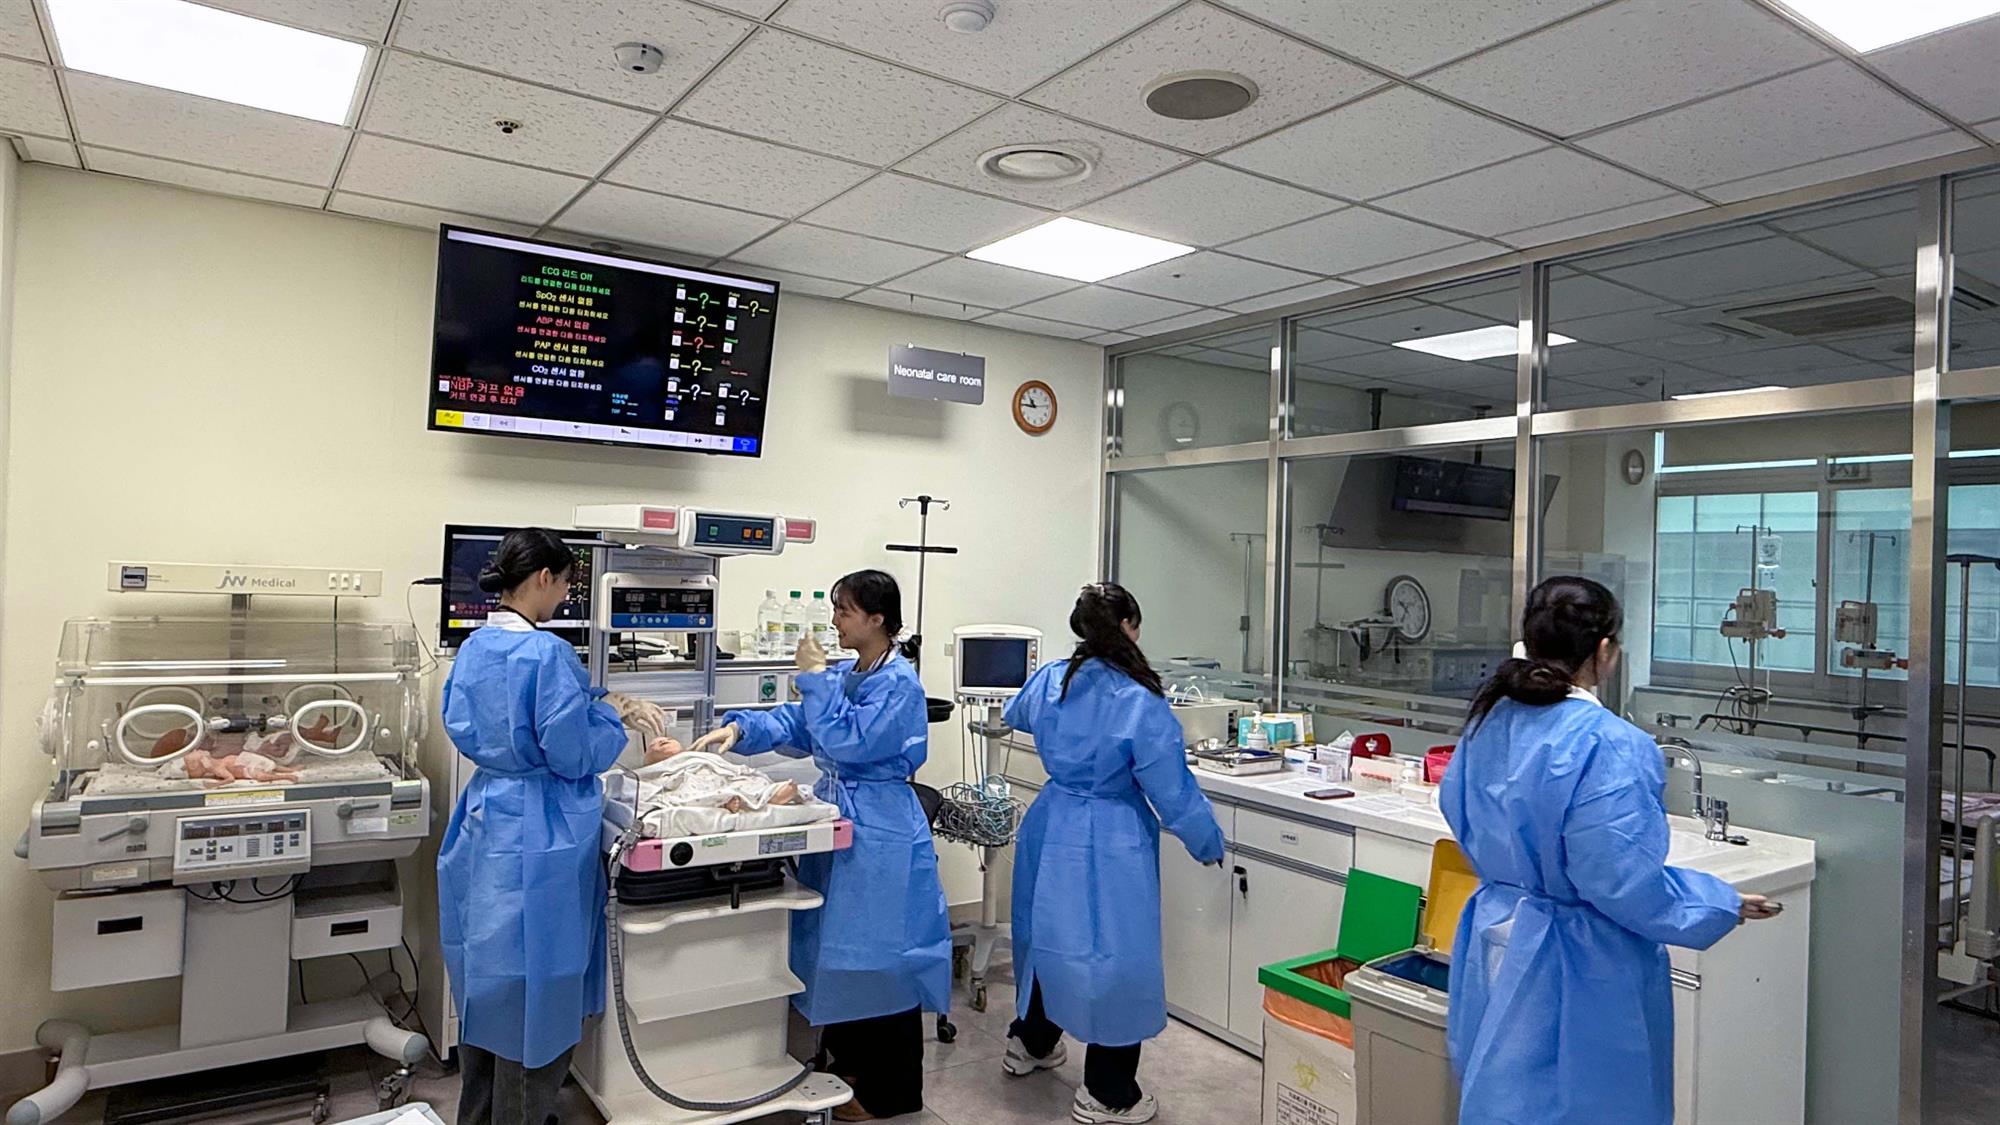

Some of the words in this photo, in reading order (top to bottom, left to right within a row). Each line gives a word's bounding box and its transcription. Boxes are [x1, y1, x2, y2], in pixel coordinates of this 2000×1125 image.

[542, 266, 560, 276] ECG
[562, 269, 578, 279] 리드
[580, 273, 593, 281] Off
[559, 294, 575, 304] 센서
[555, 319, 571, 328] 센서
[534, 340, 551, 349] PAP
[553, 342, 569, 352] 센서
[551, 366, 567, 376] 센서
[894, 364, 934, 380] Neonatal
[937, 372, 957, 384] care
[960, 376, 982, 387] room
[451, 380, 474, 391] NBP
[504, 385, 525, 397] 없음
[251, 578, 296, 588] Medical
